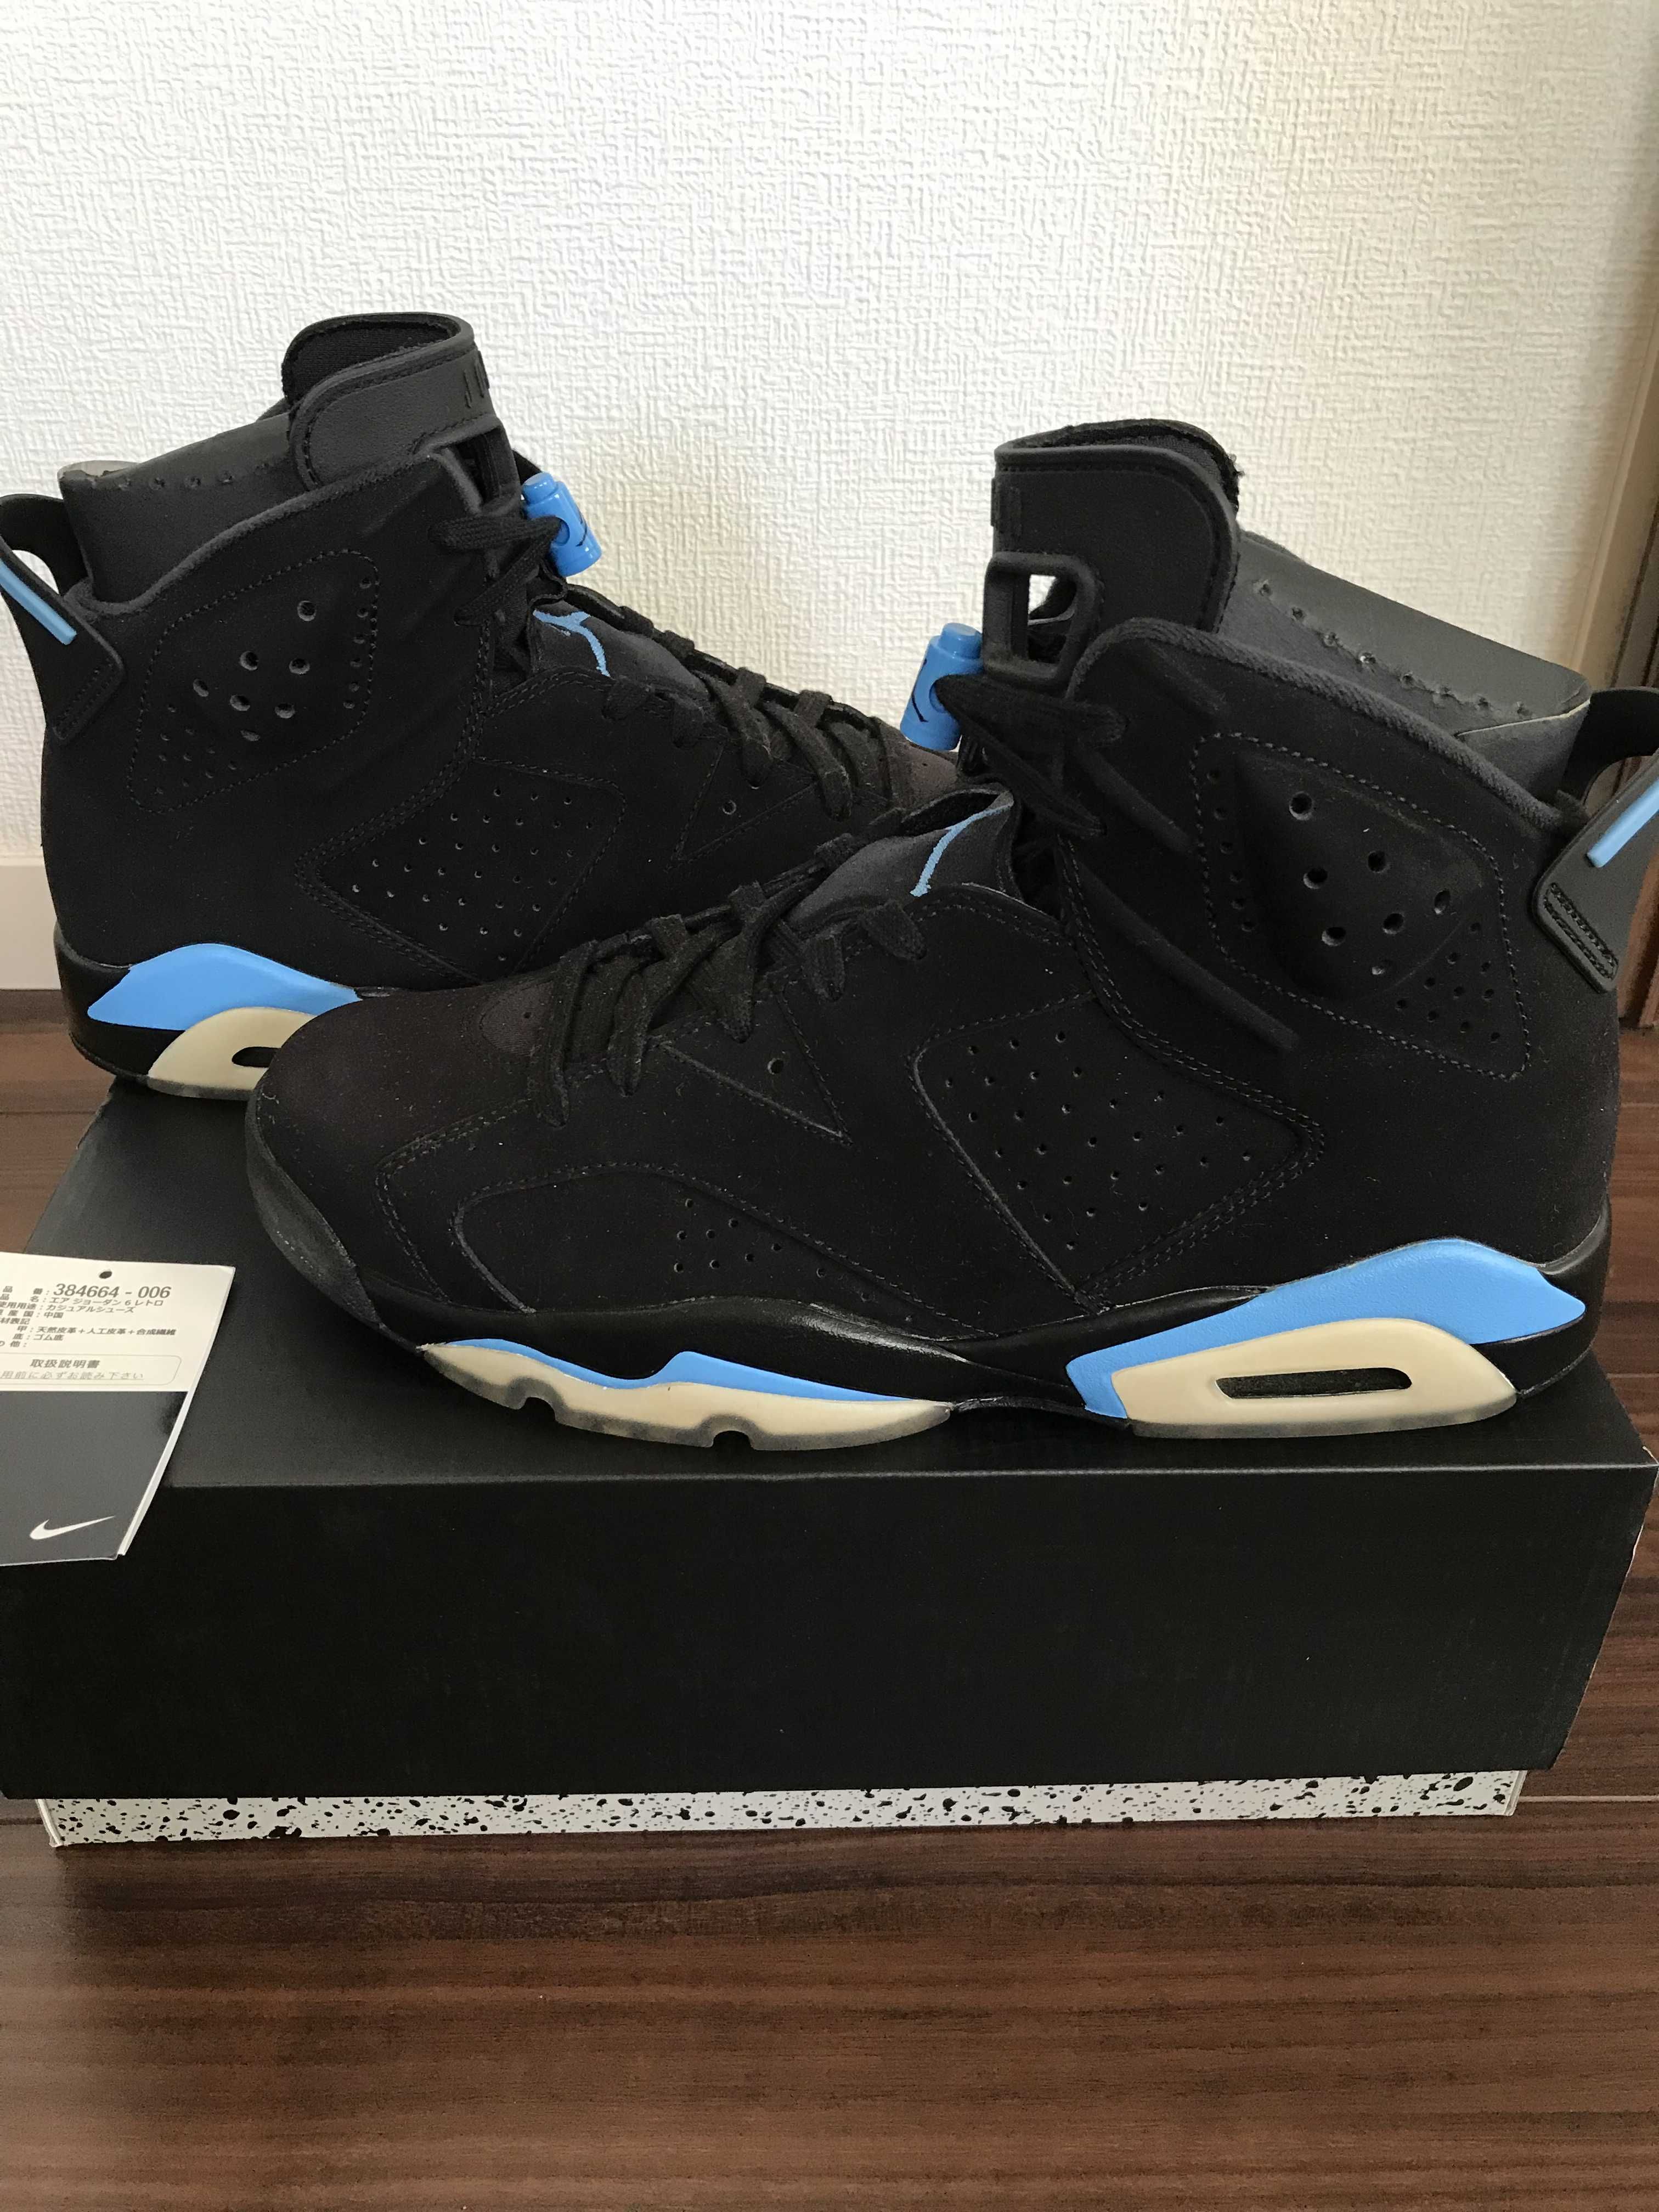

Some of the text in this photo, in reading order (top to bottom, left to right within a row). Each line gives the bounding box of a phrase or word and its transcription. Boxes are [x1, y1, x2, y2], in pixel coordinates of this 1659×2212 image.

[53, 1283, 120, 1298] 384664
[138, 1286, 172, 1299] 006
[73, 1298, 121, 1306] ジョーダン
[30, 1359, 100, 1369] 取扱説明書
